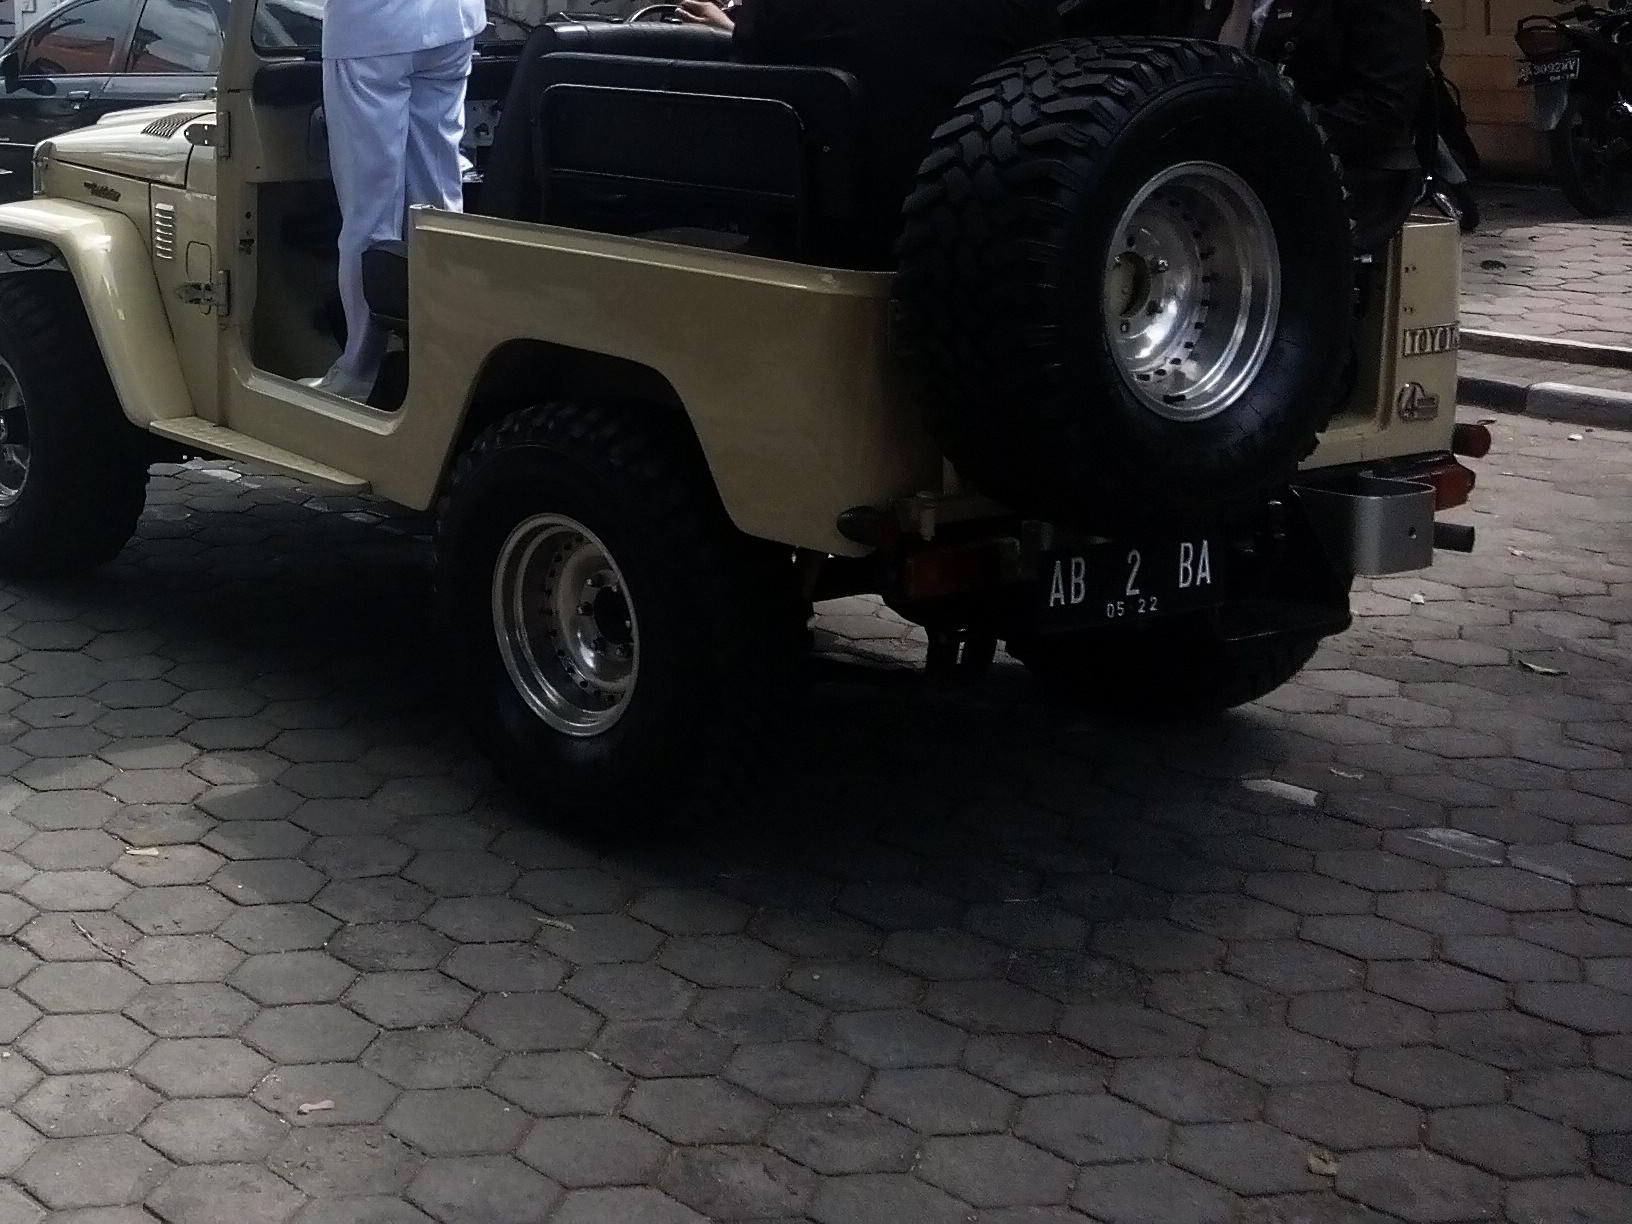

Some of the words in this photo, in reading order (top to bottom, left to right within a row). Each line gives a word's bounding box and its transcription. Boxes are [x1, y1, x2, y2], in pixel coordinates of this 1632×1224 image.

[1049, 556, 1086, 607] AB
[1125, 549, 1142, 597] 2
[1178, 539, 1211, 589] BA
[1106, 600, 1125, 618] 05
[1137, 595, 1158, 614] 22
